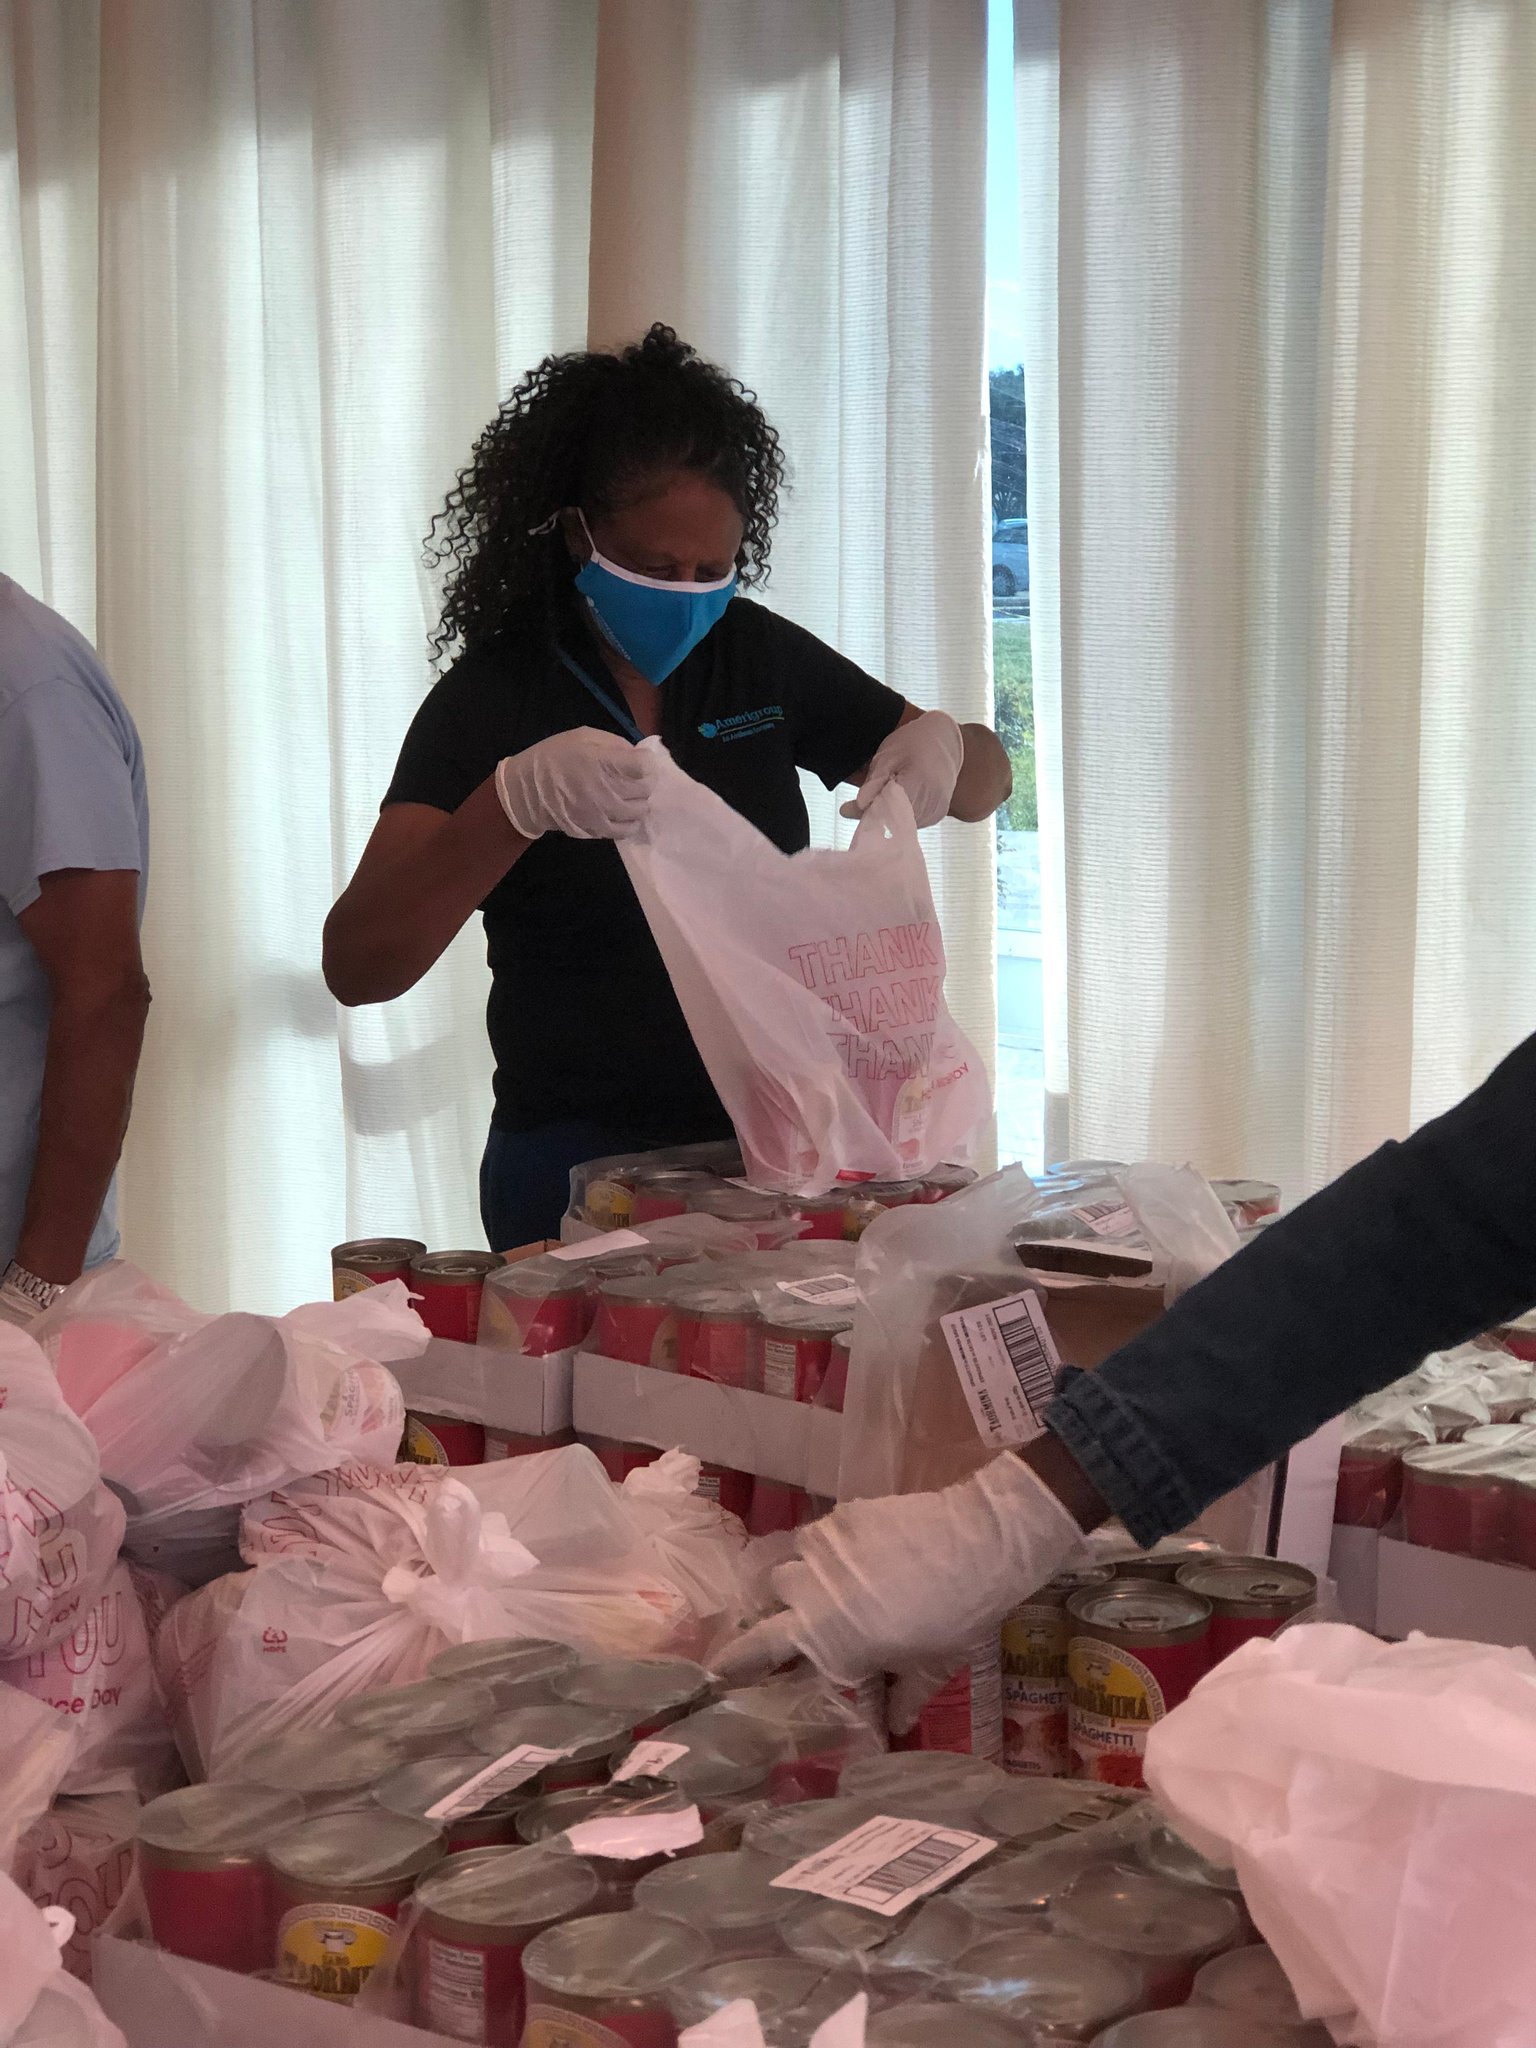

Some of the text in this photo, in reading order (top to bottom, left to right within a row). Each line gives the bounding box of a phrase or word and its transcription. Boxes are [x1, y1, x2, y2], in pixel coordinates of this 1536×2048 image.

[715, 704, 784, 730] Amerigroup
[788, 922, 939, 989] THANK
[820, 976, 940, 1034] HANK
[826, 1032, 936, 1080] HAN
[1005, 1687, 1067, 1705] SPAGHET
[1072, 1722, 1134, 1747] SPAGHETTI
